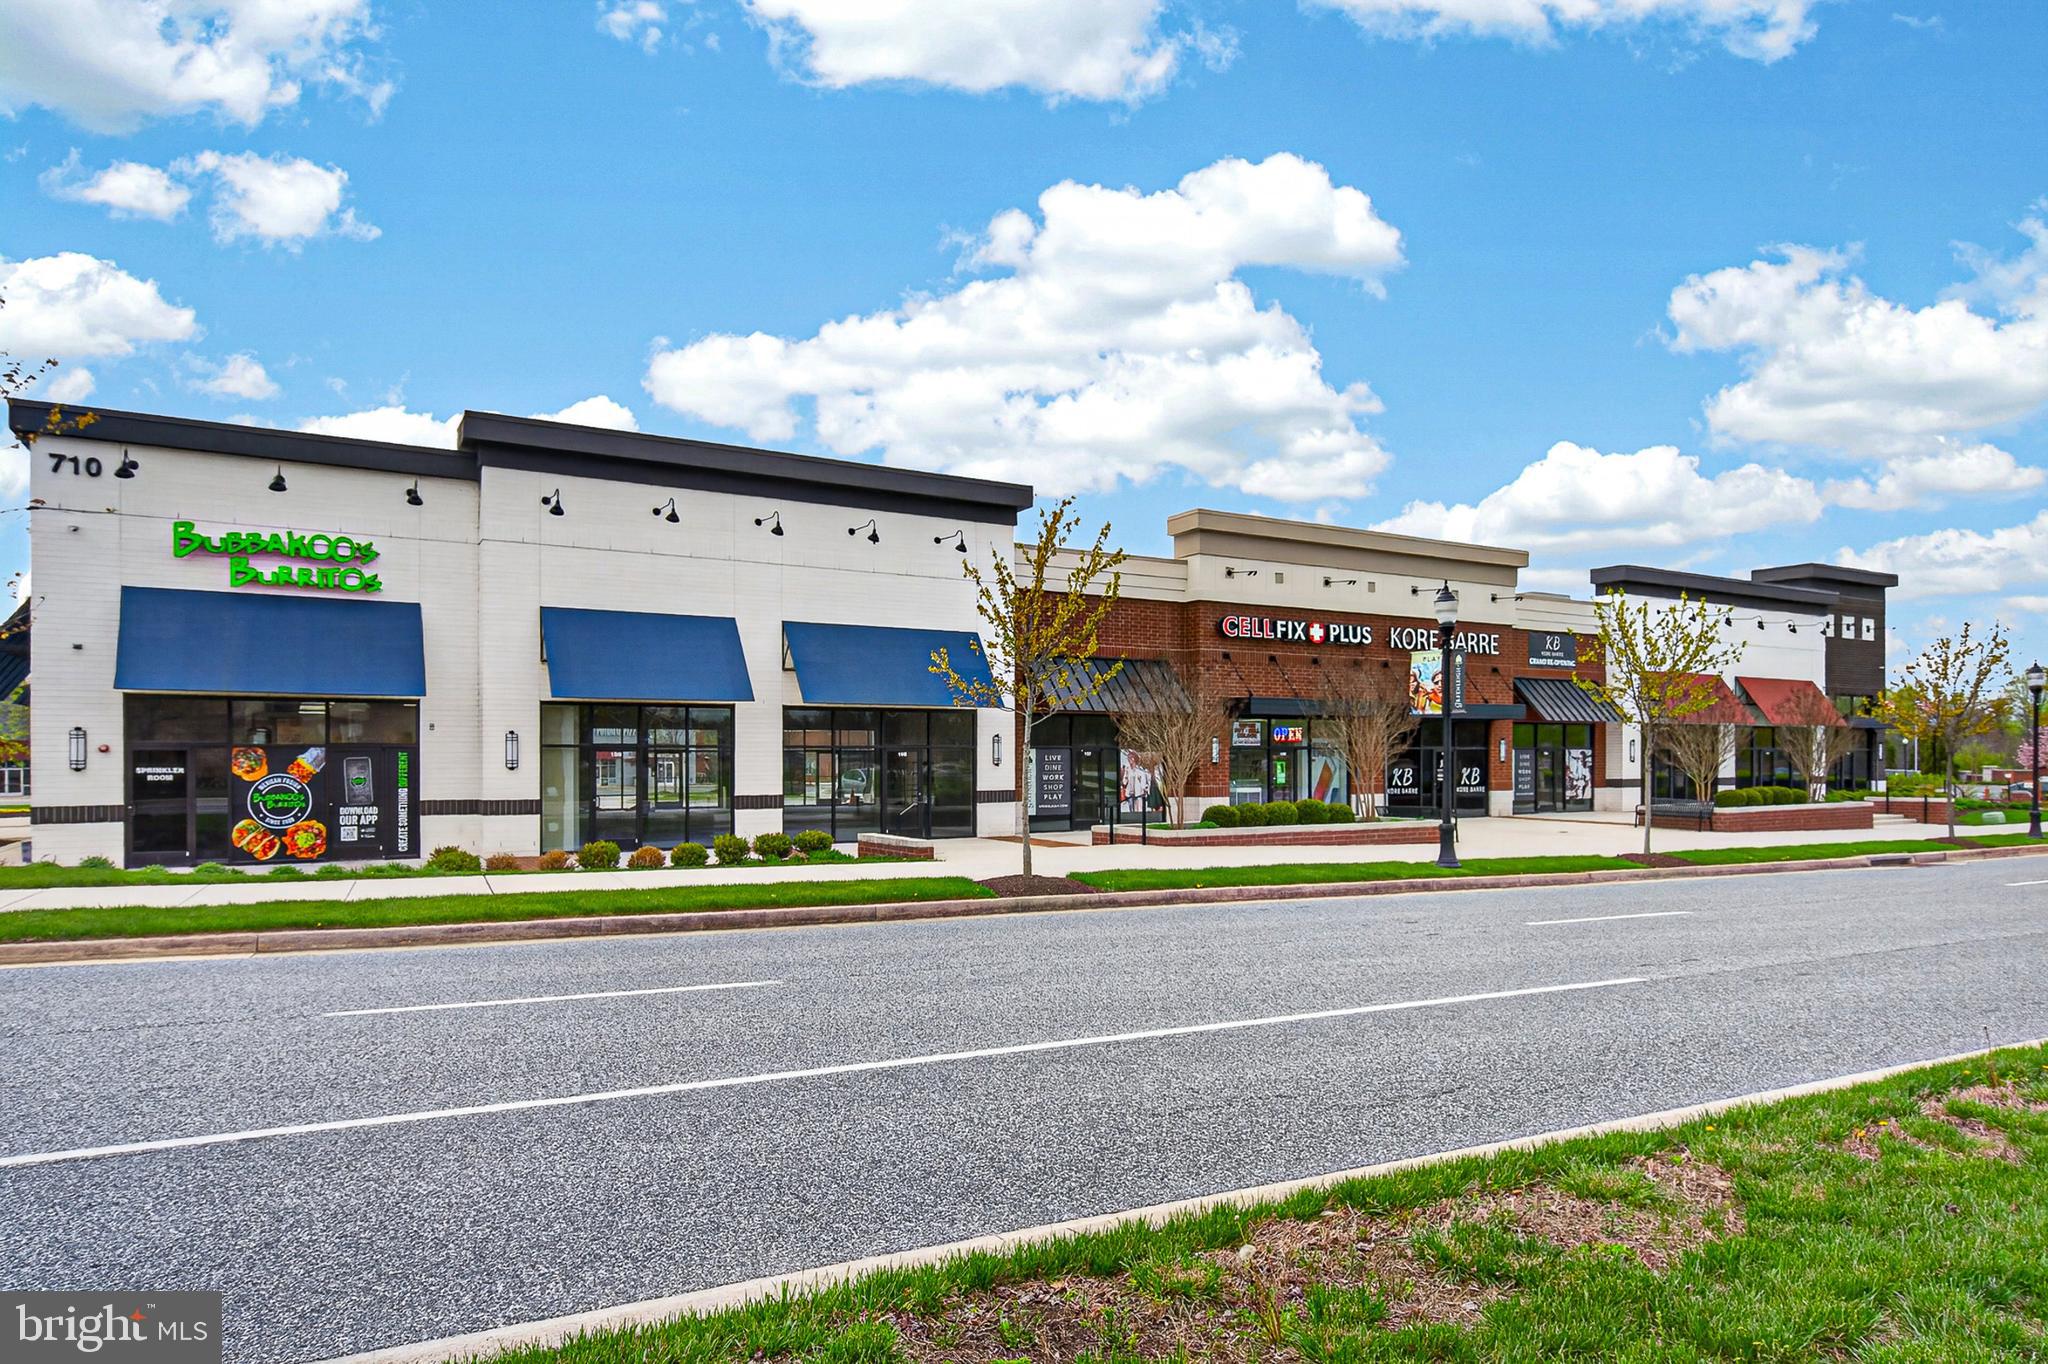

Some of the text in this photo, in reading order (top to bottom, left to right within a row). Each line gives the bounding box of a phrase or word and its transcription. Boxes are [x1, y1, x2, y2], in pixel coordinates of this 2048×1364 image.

[48, 452, 102, 478] 710
[173, 521, 380, 564] BUBBAKOO'S
[230, 557, 382, 593] BURRITOS
[1329, 624, 1372, 644] PLUS
[1390, 626, 1440, 650] KORE
[1546, 635, 1560, 650] KB
[1273, 726, 1303, 742] OPEN
[1392, 767, 1413, 786] KB
[1460, 767, 1480, 785] KB
[340, 806, 379, 815] DOWNLOAD
[398, 751, 409, 852] CREATE SOMETHING DIFFERENT
[340, 815, 378, 826] OUR APP
